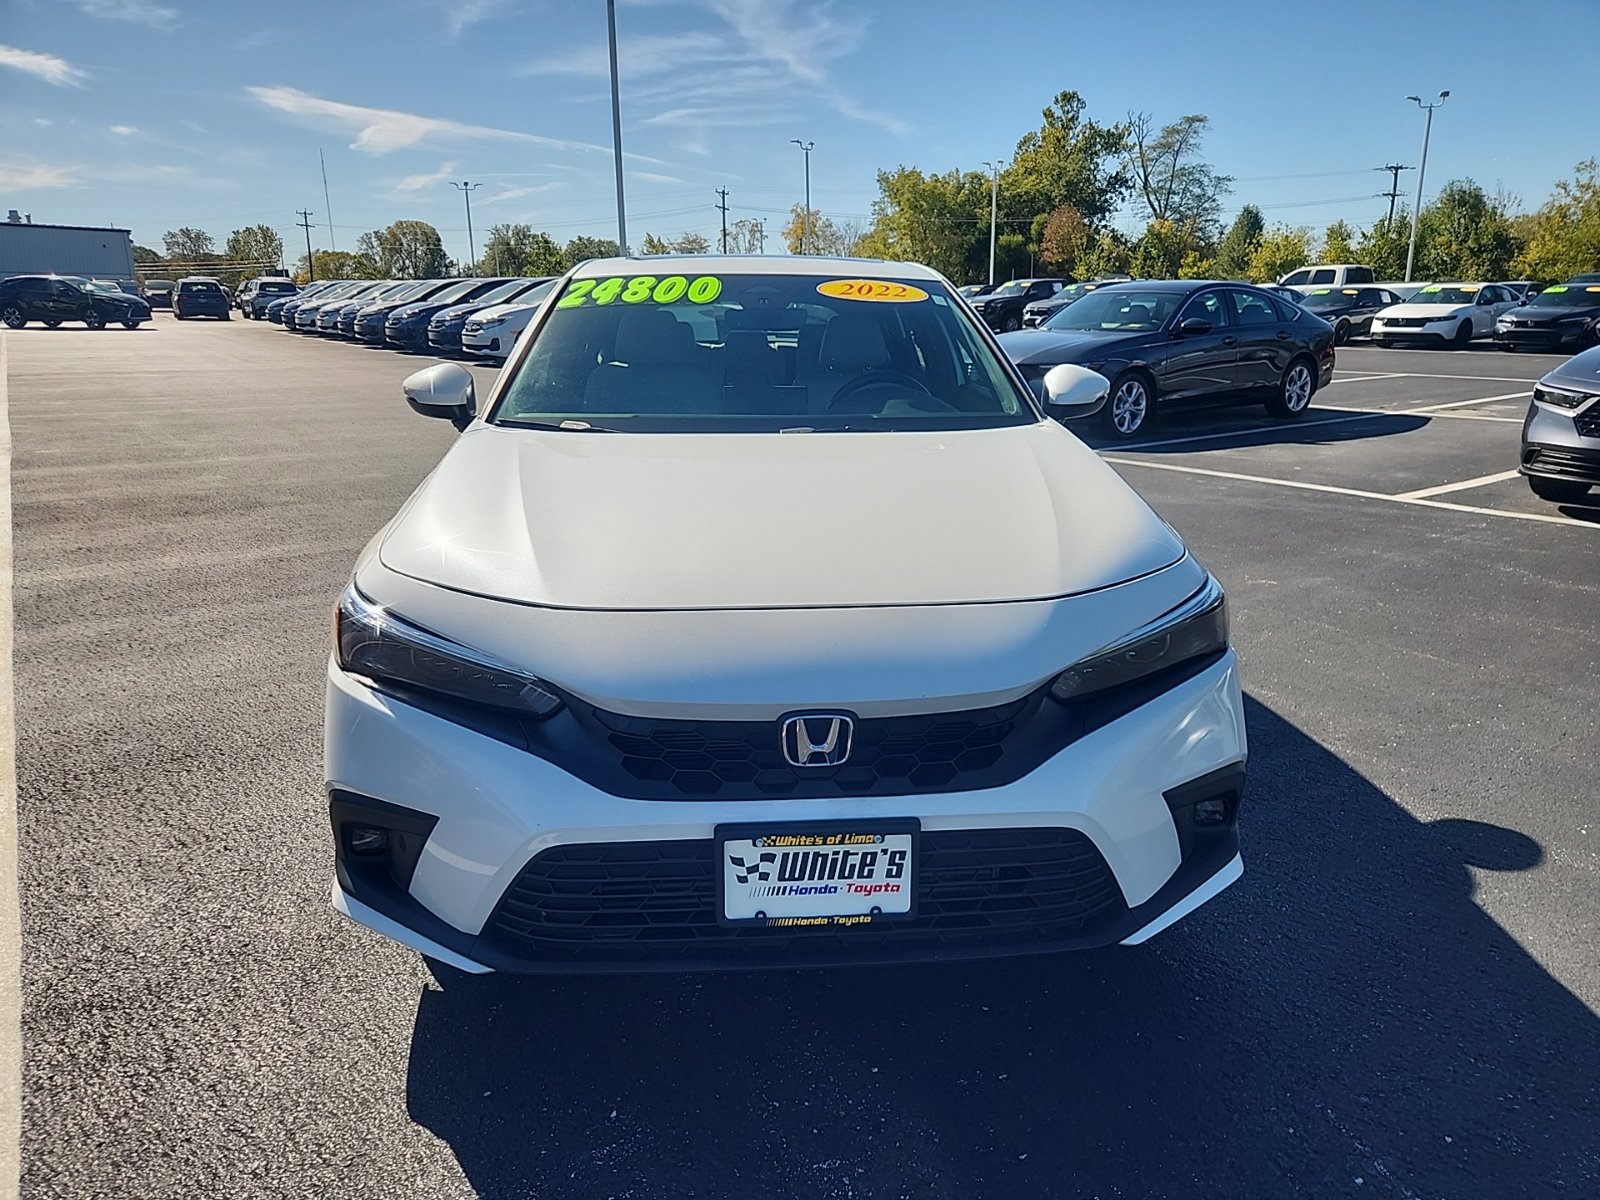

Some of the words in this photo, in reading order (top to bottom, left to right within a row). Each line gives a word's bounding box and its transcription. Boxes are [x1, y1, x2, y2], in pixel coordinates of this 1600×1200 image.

[556, 276, 722, 309] 24800
[840, 283, 907, 298] 2022
[775, 834, 823, 846] White's
[826, 833, 842, 845] of
[844, 833, 874, 844] Lima
[777, 848, 907, 882] White's
[788, 884, 838, 896] Honda
[846, 883, 901, 896] Toyota
[793, 917, 828, 926] Honda
[832, 915, 872, 926] Toyota
